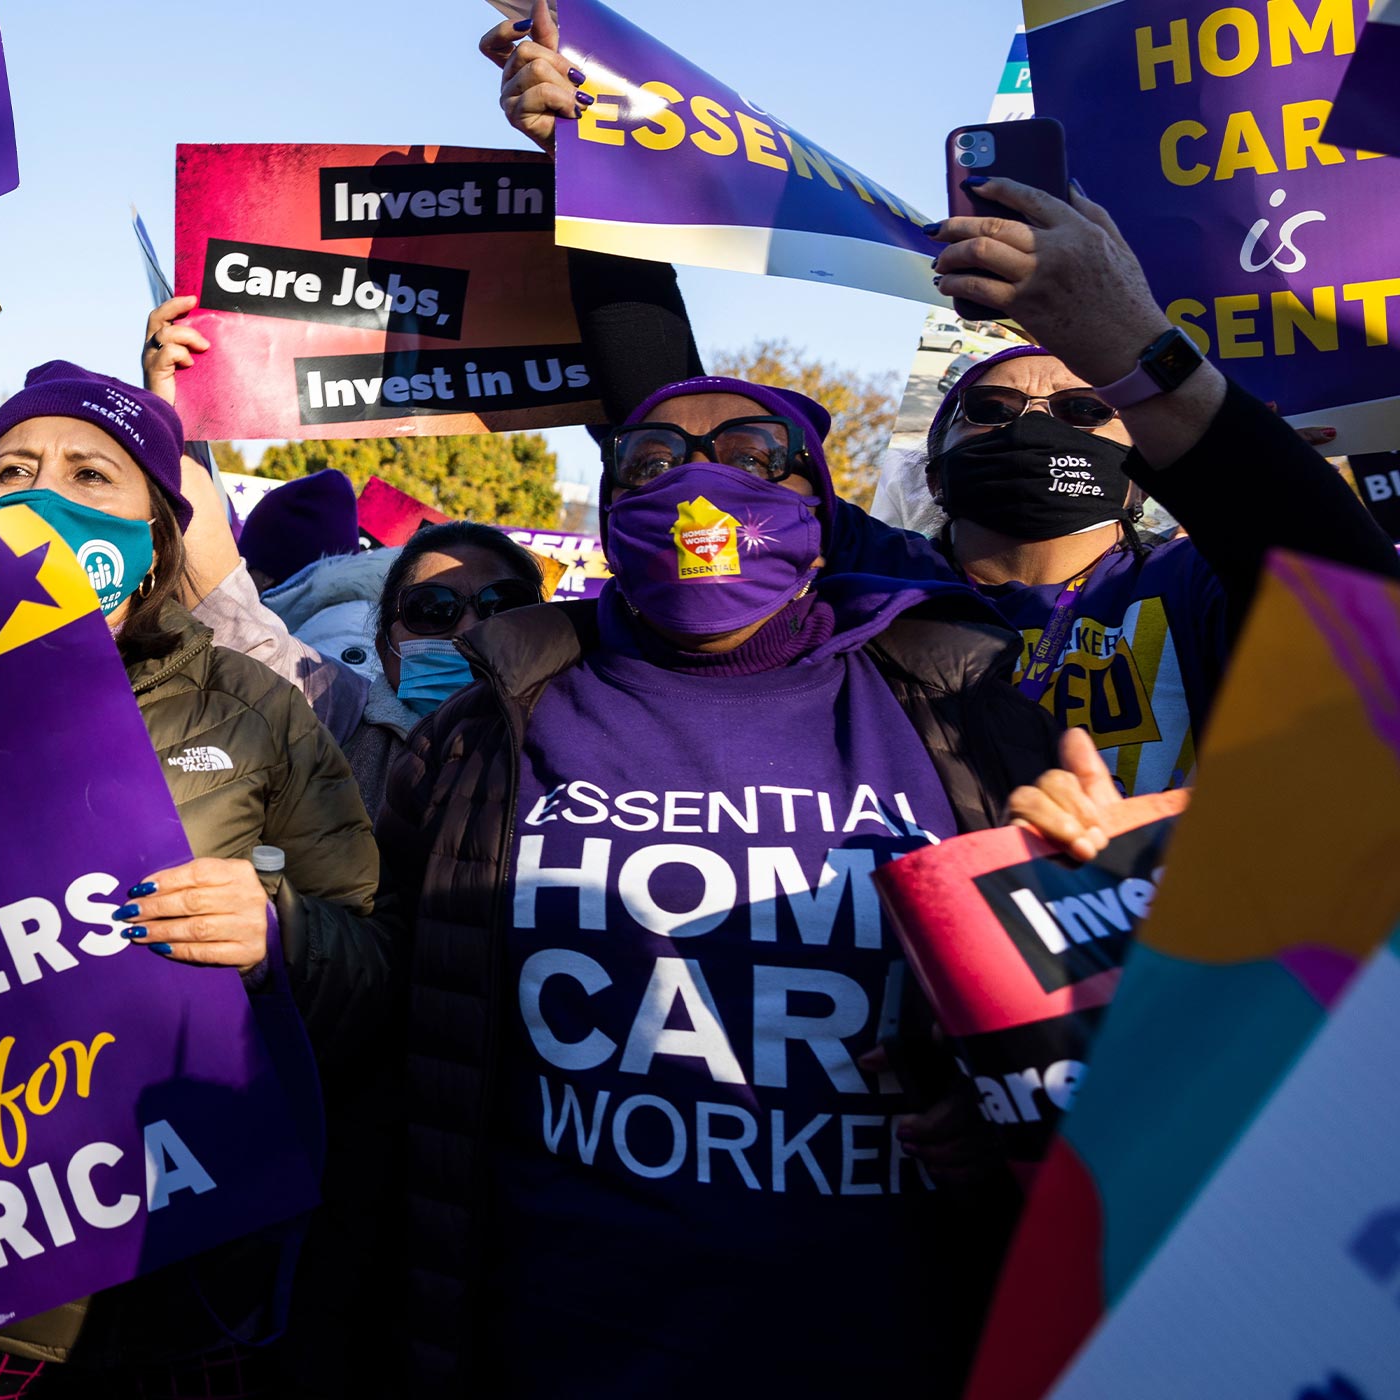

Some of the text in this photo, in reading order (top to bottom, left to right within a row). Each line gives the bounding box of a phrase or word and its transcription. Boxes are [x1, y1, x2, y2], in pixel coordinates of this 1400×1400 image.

[1135, 0, 1376, 91] HOM
[1160, 99, 1388, 187] CAR
[333, 176, 543, 222] Invest in
[1239, 188, 1326, 273] is
[214, 251, 451, 326] Care Jobs,
[306, 357, 590, 409] Invest in Us
[1048, 455, 1092, 468] Jobs.
[1049, 468, 1095, 481] Care.
[1048, 479, 1105, 497] Justice.
[695, 544, 718, 554] are
[167, 754, 209, 766] NORTH
[182, 763, 212, 772] FACE
[183, 746, 208, 756] THE
[524, 779, 941, 845] ESSENTIAL
[513, 834, 910, 950] HOM
[1009, 865, 1166, 956] Inve
[954, 1058, 1089, 1125] are
